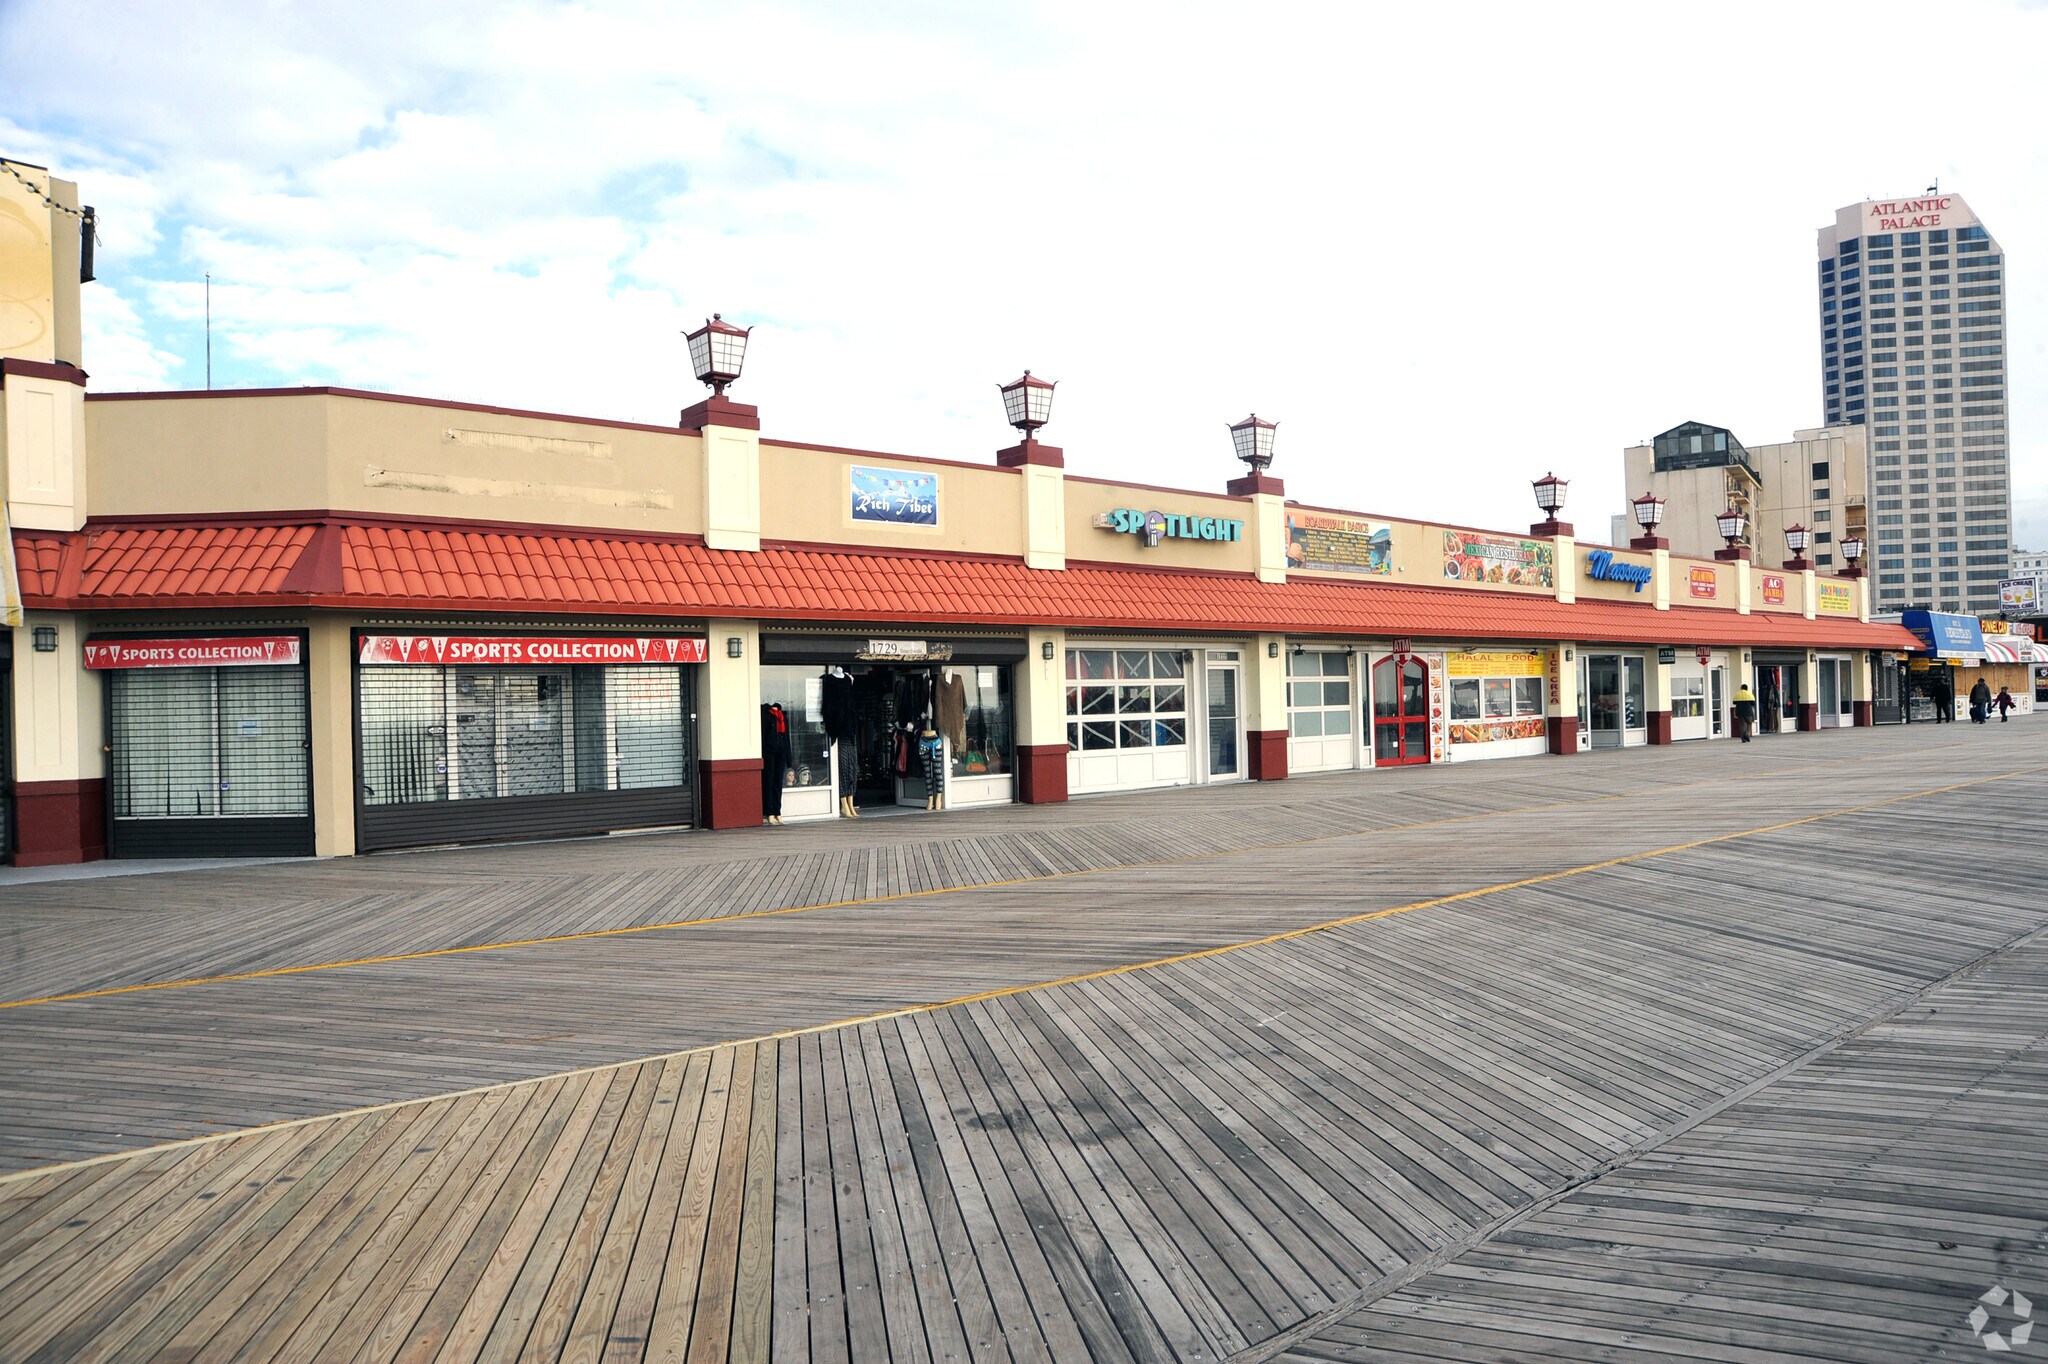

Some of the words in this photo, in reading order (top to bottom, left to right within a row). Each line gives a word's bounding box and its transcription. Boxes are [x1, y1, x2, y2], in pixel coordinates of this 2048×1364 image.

[1870, 198, 1951, 216] ATLANTIC
[1880, 214, 1941, 230] PALACE
[855, 495, 890, 513] Rich
[895, 496, 933, 515] Tibet
[1465, 543, 1495, 559] MEXICAN
[1588, 548, 1652, 592] Massage
[1768, 578, 1780, 588] AC
[2021, 601, 2034, 609] CAKE
[122, 648, 175, 661] SPORTS
[178, 645, 262, 659] COLLECTION
[450, 643, 522, 658] SPORTS
[527, 643, 634, 658] COLLECTION
[871, 643, 898, 654] 1729
[1393, 642, 1411, 652] ATM
[1696, 646, 1710, 656] ATM
[1457, 654, 1494, 662] HALAL
[1549, 653, 1558, 673] ICE
